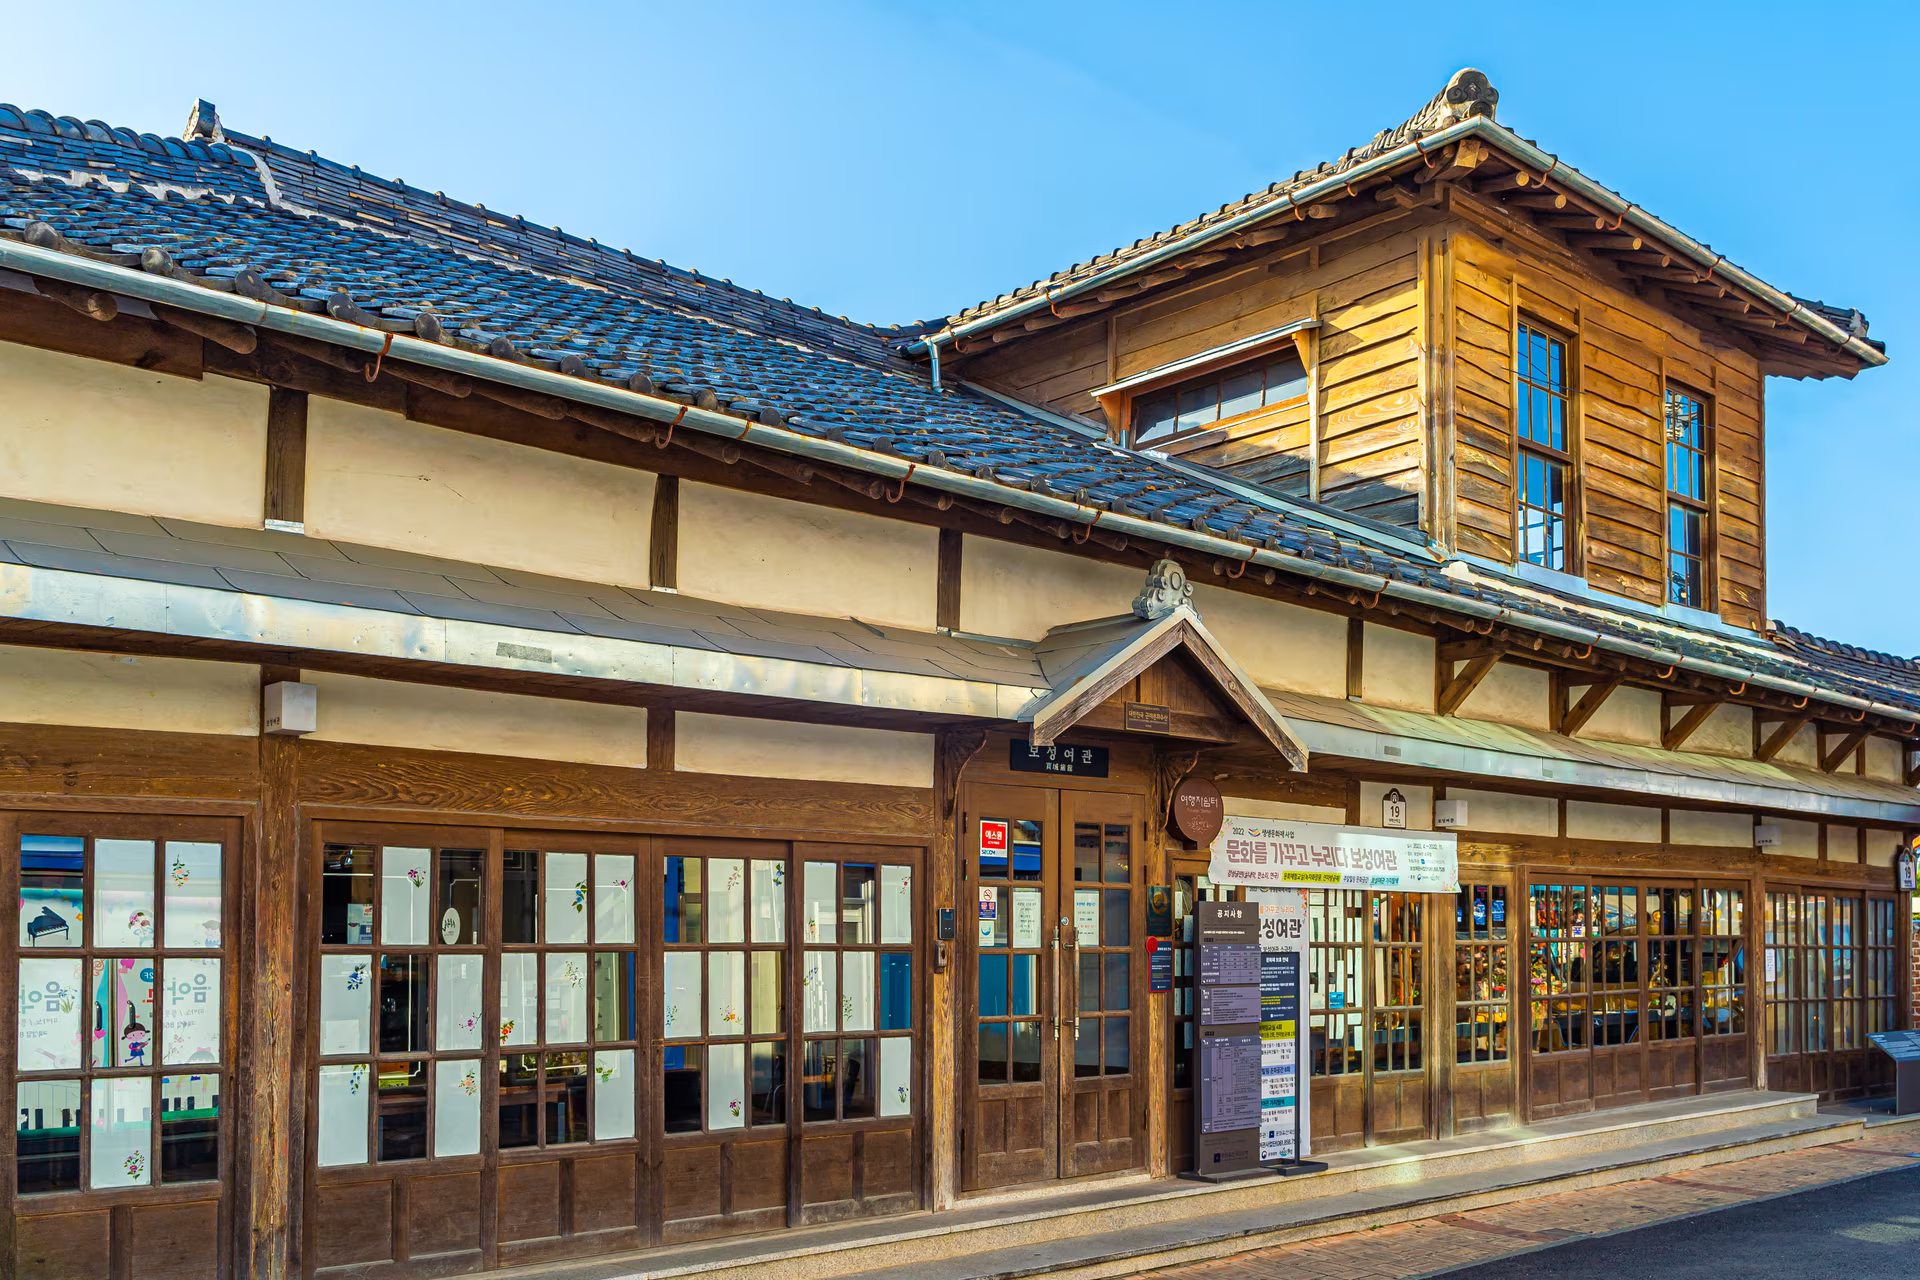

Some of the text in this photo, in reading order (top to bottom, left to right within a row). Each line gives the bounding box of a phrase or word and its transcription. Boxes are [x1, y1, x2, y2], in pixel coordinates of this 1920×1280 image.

[1028, 746, 1092, 764] 보성여관
[1390, 805, 1400, 818] 19
[985, 830, 1002, 840] 에스원
[1232, 827, 1244, 836] 2022
[1226, 840, 1397, 870] 문화를 가꾸고 누리다 보성여관
[1217, 908, 1242, 918] 공지사항
[1259, 918, 1302, 939] 성여관
